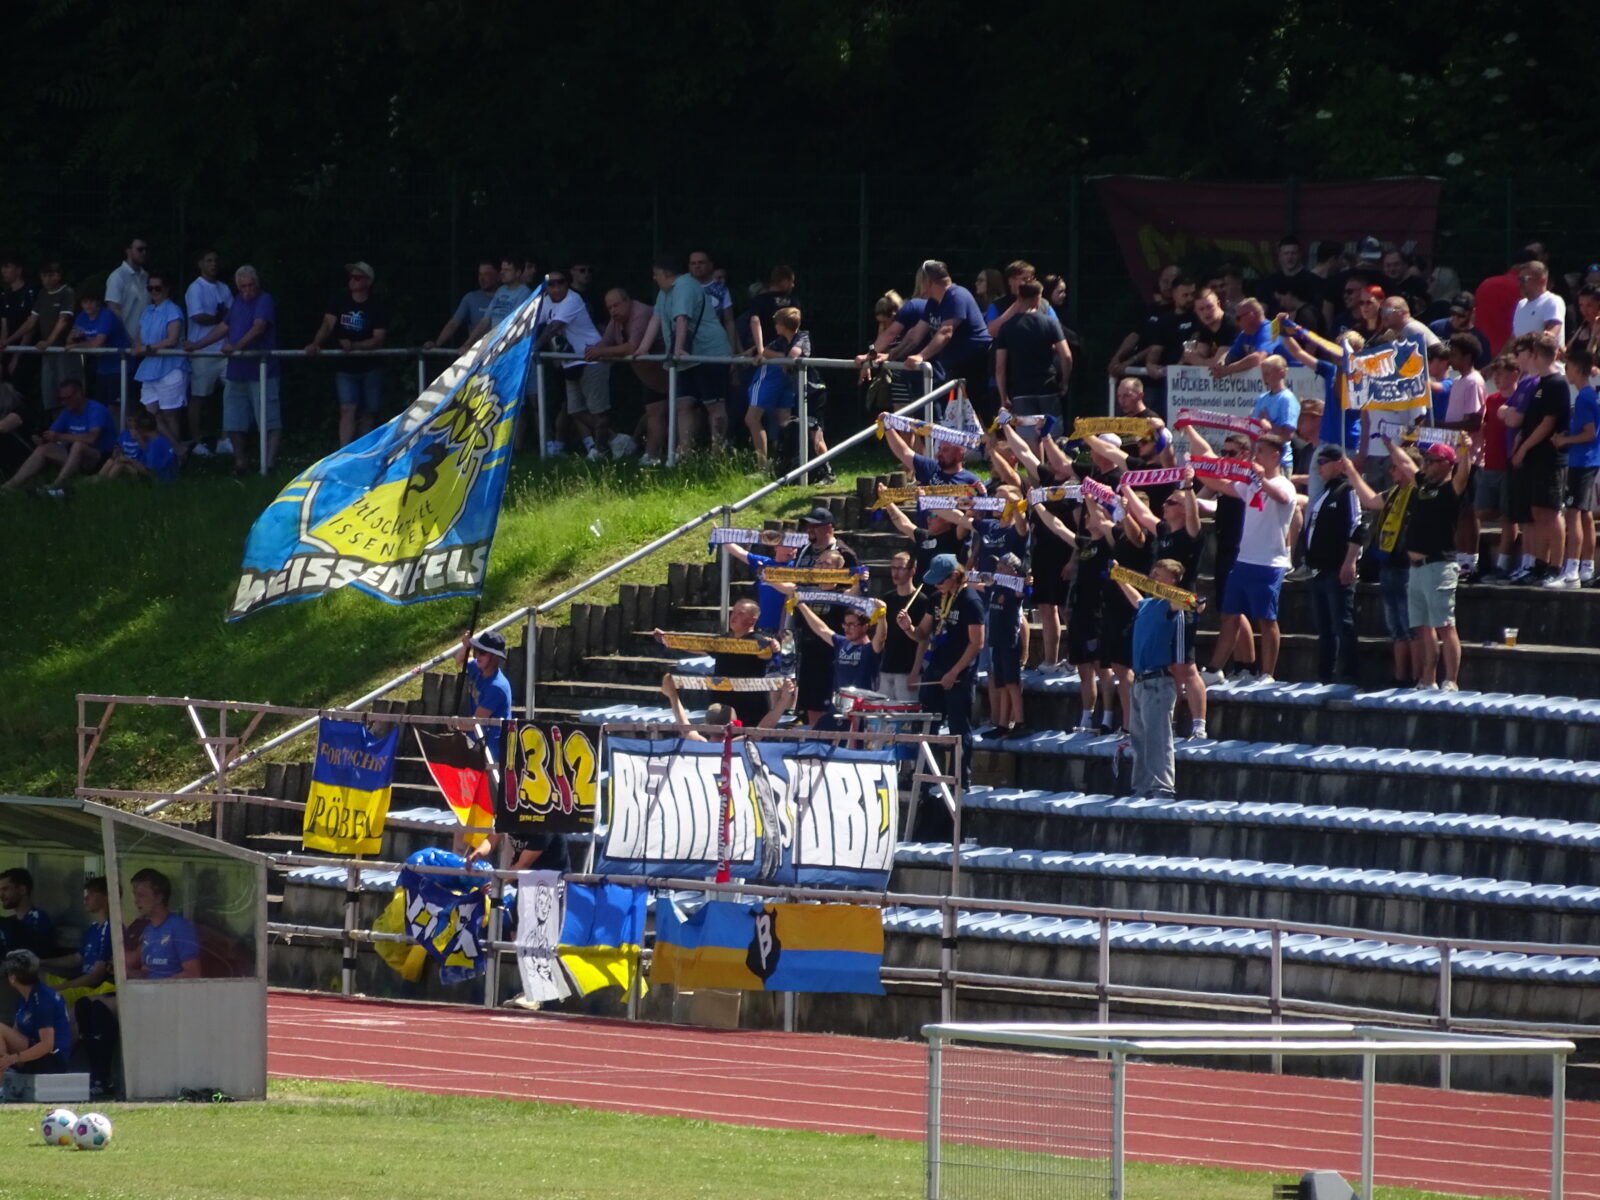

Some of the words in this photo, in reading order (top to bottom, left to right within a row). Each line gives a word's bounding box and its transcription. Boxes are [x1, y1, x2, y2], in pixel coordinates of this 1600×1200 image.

[1213, 377, 1263, 393] RECYCLING
[1223, 396, 1236, 408] und
[233, 547, 487, 612] WEISSENFELS
[304, 796, 382, 840] PÖBEL
